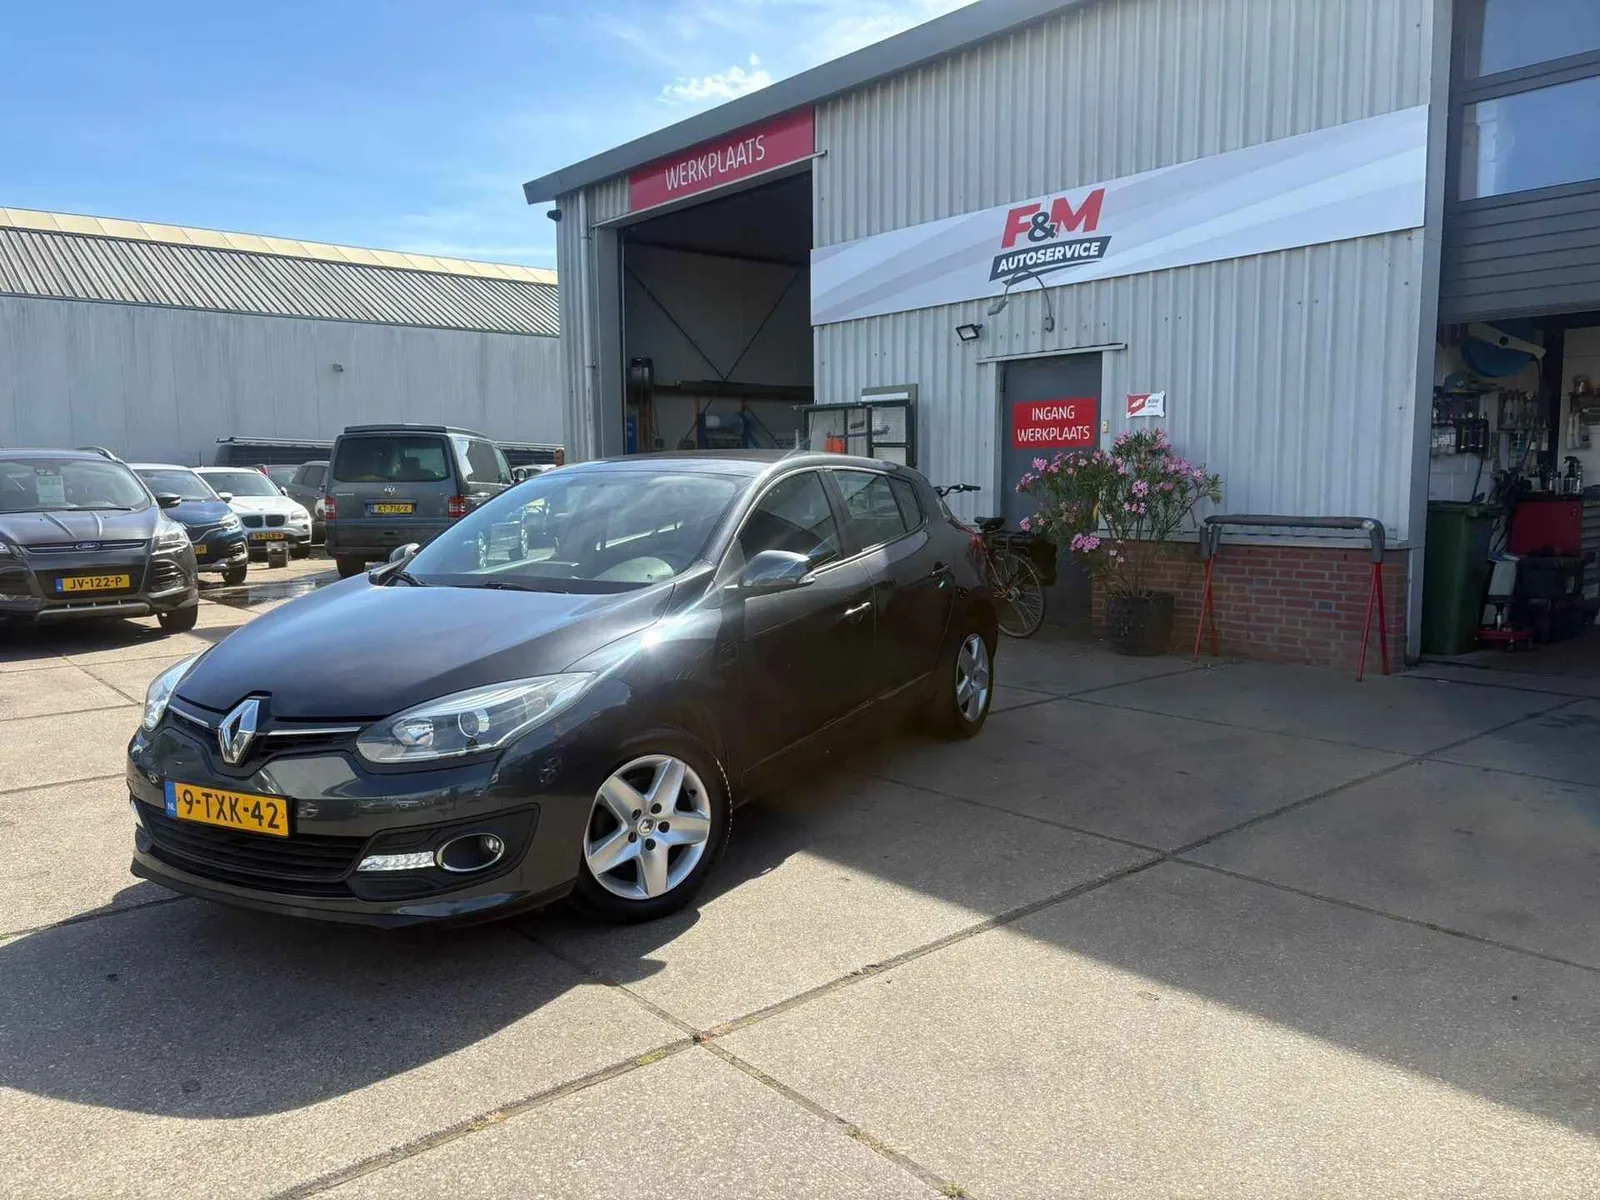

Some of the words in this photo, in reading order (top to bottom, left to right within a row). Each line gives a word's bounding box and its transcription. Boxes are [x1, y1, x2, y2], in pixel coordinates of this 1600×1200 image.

[665, 134, 765, 191] WERKPLAATS
[1001, 188, 1105, 249] F&M
[997, 242, 1101, 273] AUTOSERVICE
[1032, 405, 1075, 421] INGANG
[1017, 425, 1090, 442] WERKPLAATS
[70, 576, 122, 590] JV-122-P
[182, 788, 280, 830] 9-TXK-42
